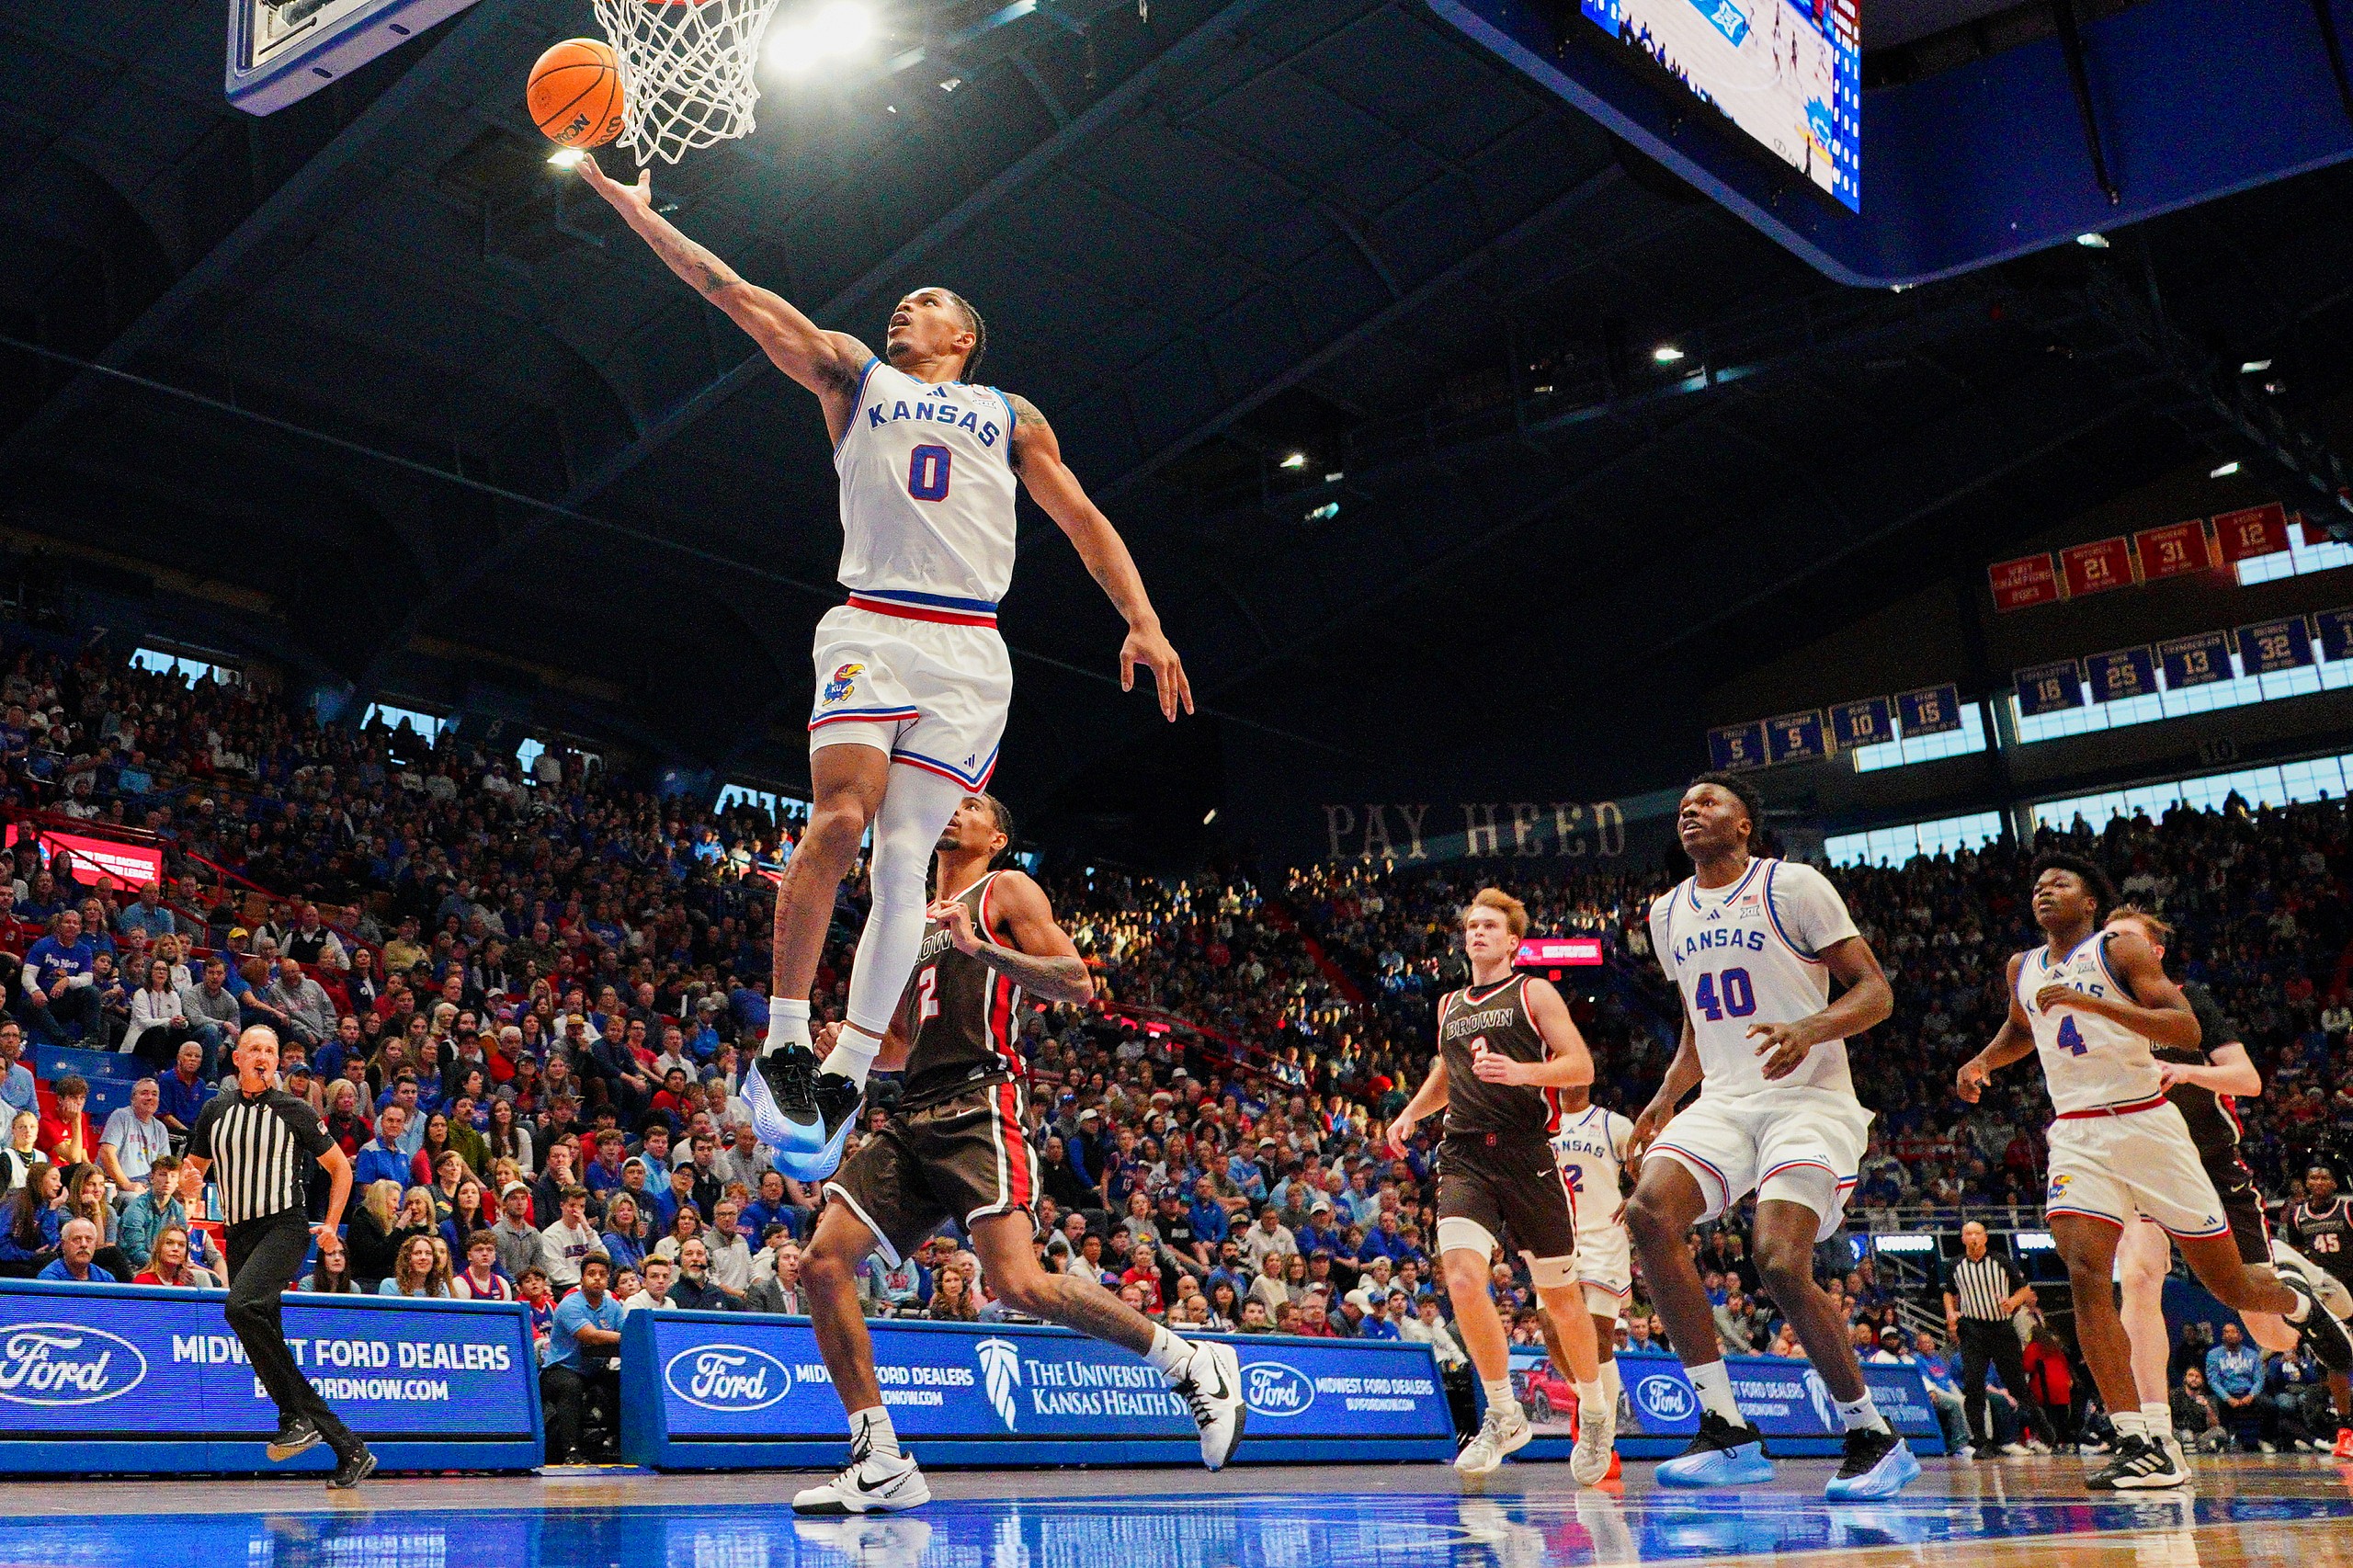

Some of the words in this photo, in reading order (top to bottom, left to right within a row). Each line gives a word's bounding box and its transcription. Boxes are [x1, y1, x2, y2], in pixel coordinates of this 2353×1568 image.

[868, 401, 1000, 448] KANSAS
[908, 444, 951, 502] 0
[2161, 540, 2186, 563] 31
[2239, 523, 2266, 548] 12
[2084, 555, 2109, 580] 21
[2183, 649, 2210, 676] 13
[2259, 633, 2291, 661] 32
[2106, 663, 2138, 690] 25
[1851, 714, 1874, 736] 10
[1731, 738, 1745, 759] 5
[1324, 802, 1428, 860] PAY
[1461, 801, 1625, 858] HEED
[1674, 928, 1765, 965] KANSAS
[1695, 967, 1756, 1022] 40
[1446, 1007, 1514, 1041] BROWN
[2057, 1013, 2087, 1058] 4
[2313, 1233, 2340, 1254] 45
[0, 1333, 111, 1391] Ford
[315, 1338, 390, 1368] FORD
[398, 1342, 511, 1371] DEALERS
[691, 1353, 768, 1400] Ford
[912, 1367, 975, 1387] DEALERS
[1249, 1368, 1302, 1408] Ford
[1315, 1377, 1362, 1395] MIDWEST
[1364, 1378, 1391, 1395] FORD
[1392, 1379, 1435, 1396] DEALERS
[1648, 1380, 1686, 1414] Ford
